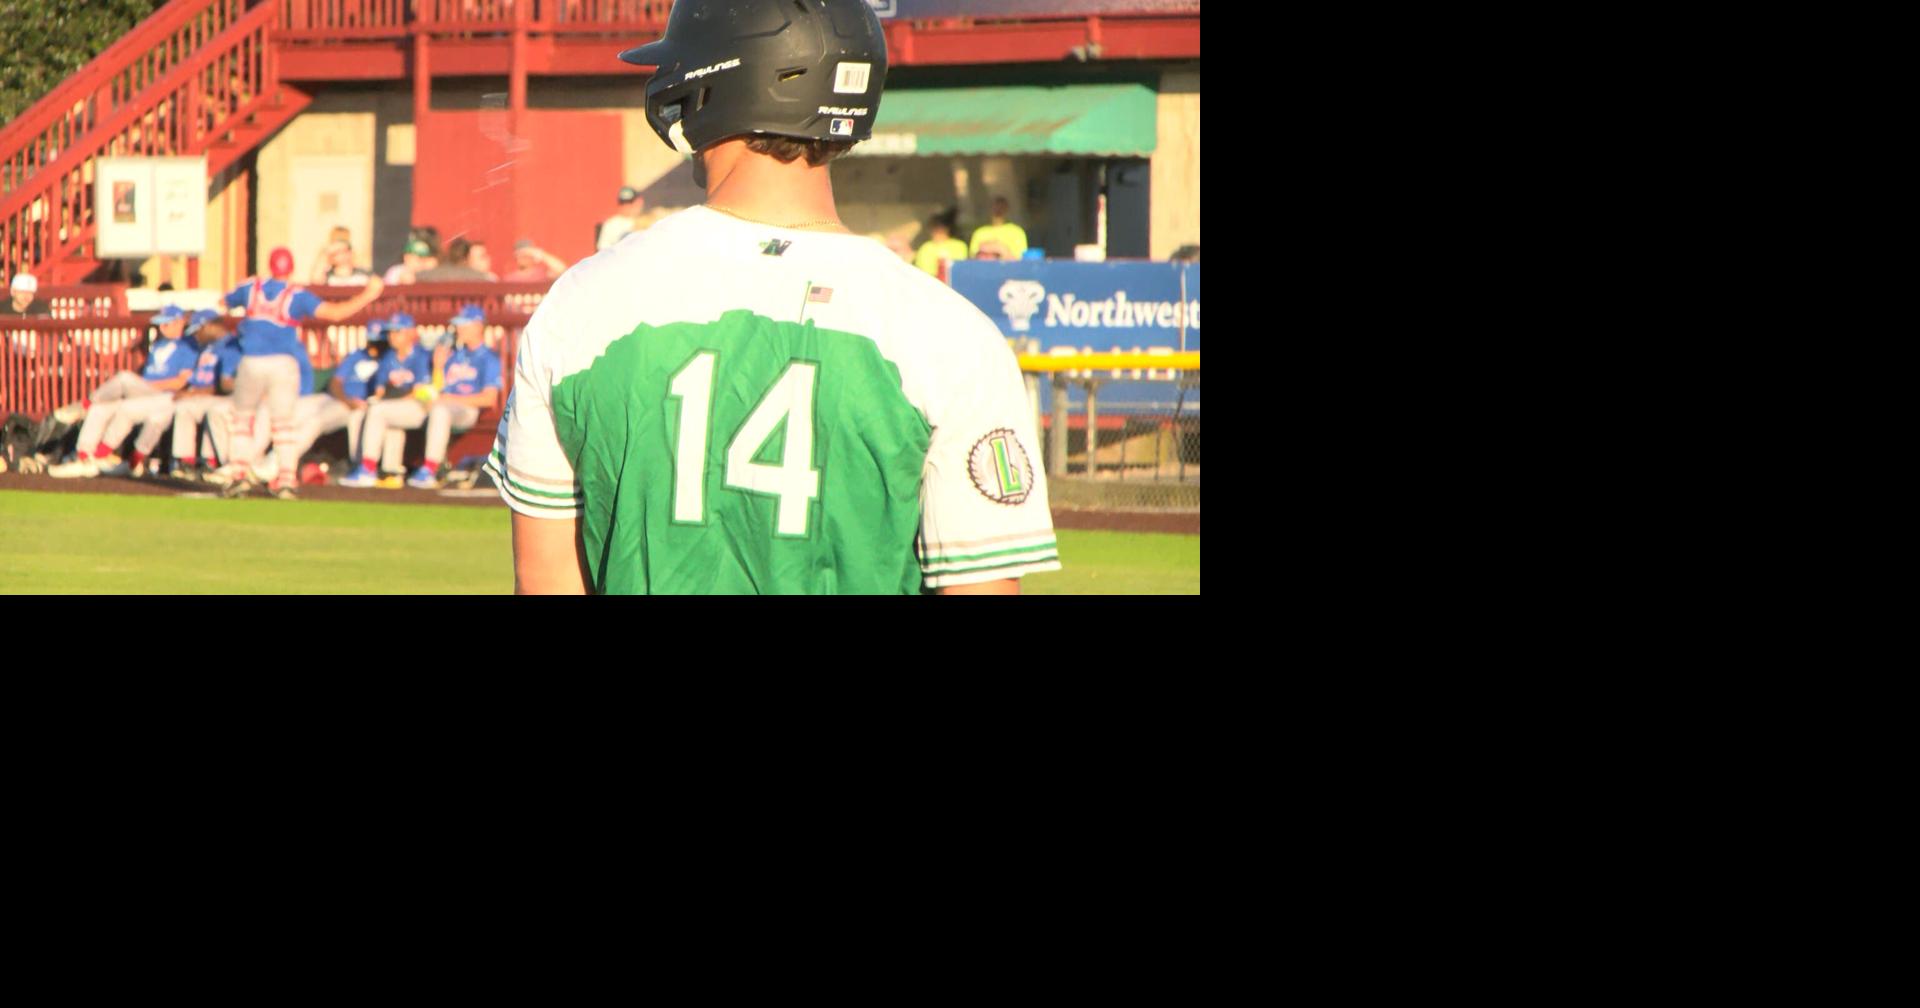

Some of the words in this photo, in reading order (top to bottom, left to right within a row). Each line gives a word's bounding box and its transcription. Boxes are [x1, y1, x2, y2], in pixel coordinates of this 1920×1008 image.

[685, 58, 741, 81] RAWLINGS
[1045, 290, 1200, 329] Northwest
[667, 348, 823, 539] 14
[989, 436, 1024, 498] L
